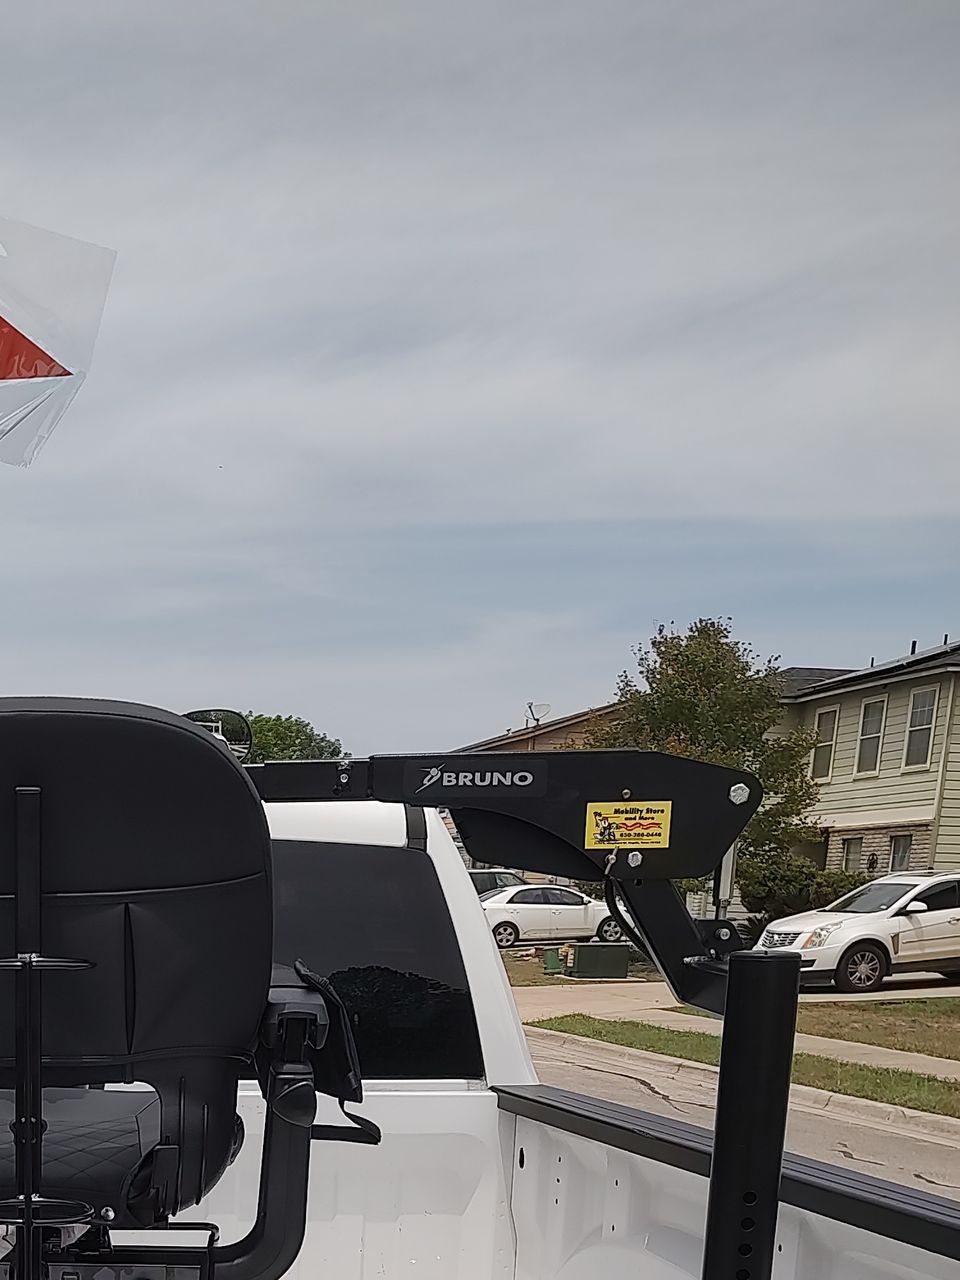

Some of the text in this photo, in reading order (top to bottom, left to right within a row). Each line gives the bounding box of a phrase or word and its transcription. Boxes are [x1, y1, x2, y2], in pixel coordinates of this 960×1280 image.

[442, 771, 534, 786] BRUNO
[613, 807, 665, 817] Mobility Store
